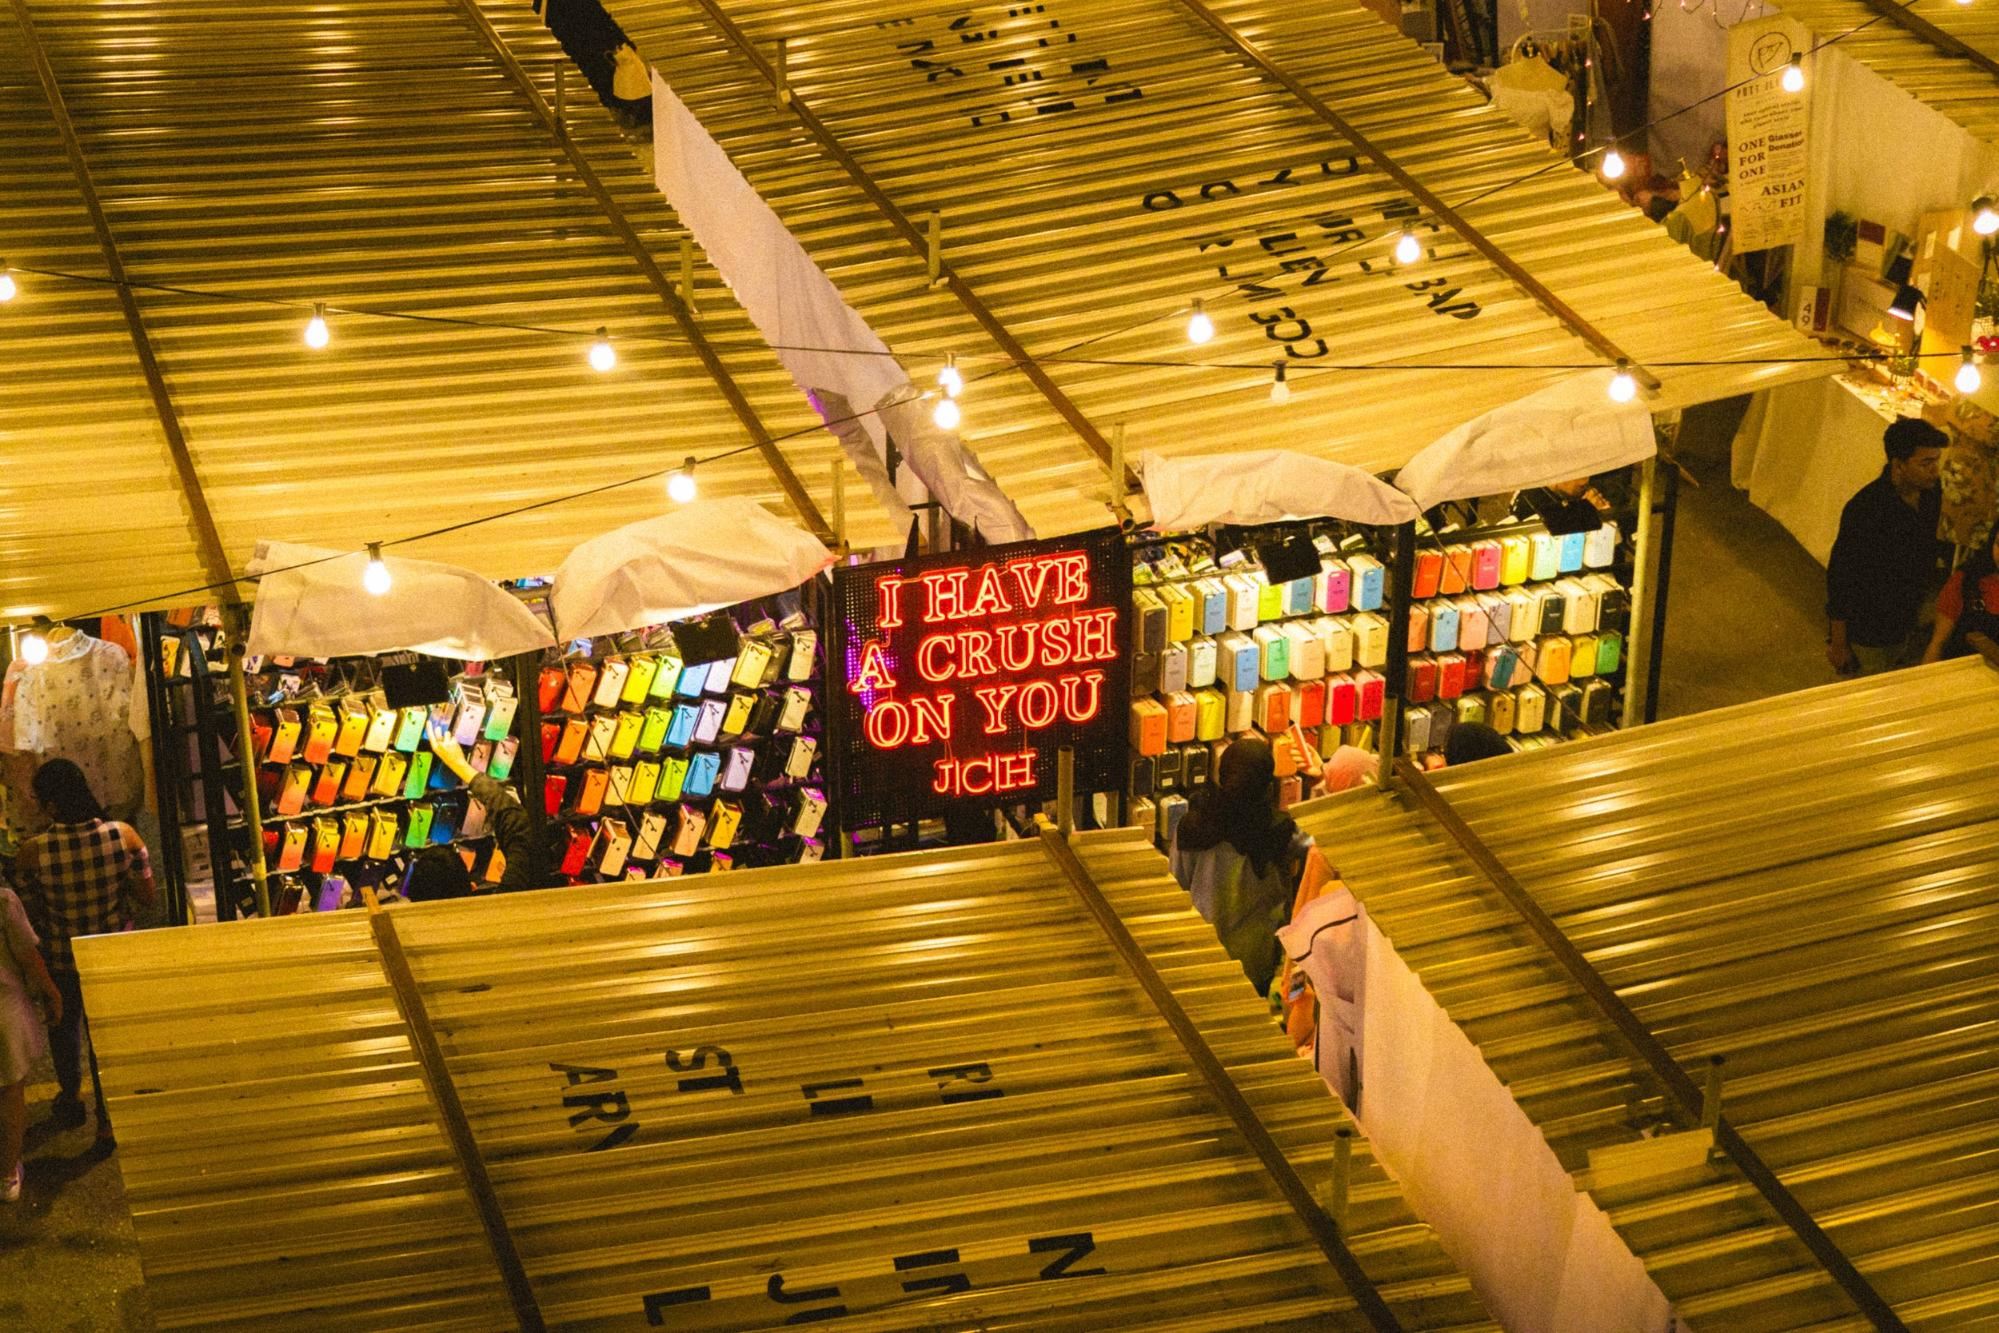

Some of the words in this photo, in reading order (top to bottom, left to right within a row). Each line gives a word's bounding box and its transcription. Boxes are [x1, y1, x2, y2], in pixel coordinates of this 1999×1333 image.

[1739, 137, 1766, 153] ONE
[1739, 152, 1766, 166] FOR
[1739, 165, 1767, 180] ONE
[1779, 194, 1803, 208] FIT
[878, 578, 903, 629] I
[923, 555, 1090, 624] HAVE
[848, 642, 897, 694] A
[916, 611, 1119, 683] CRUSH
[866, 693, 956, 749] ON
[975, 673, 1106, 735] YOU
